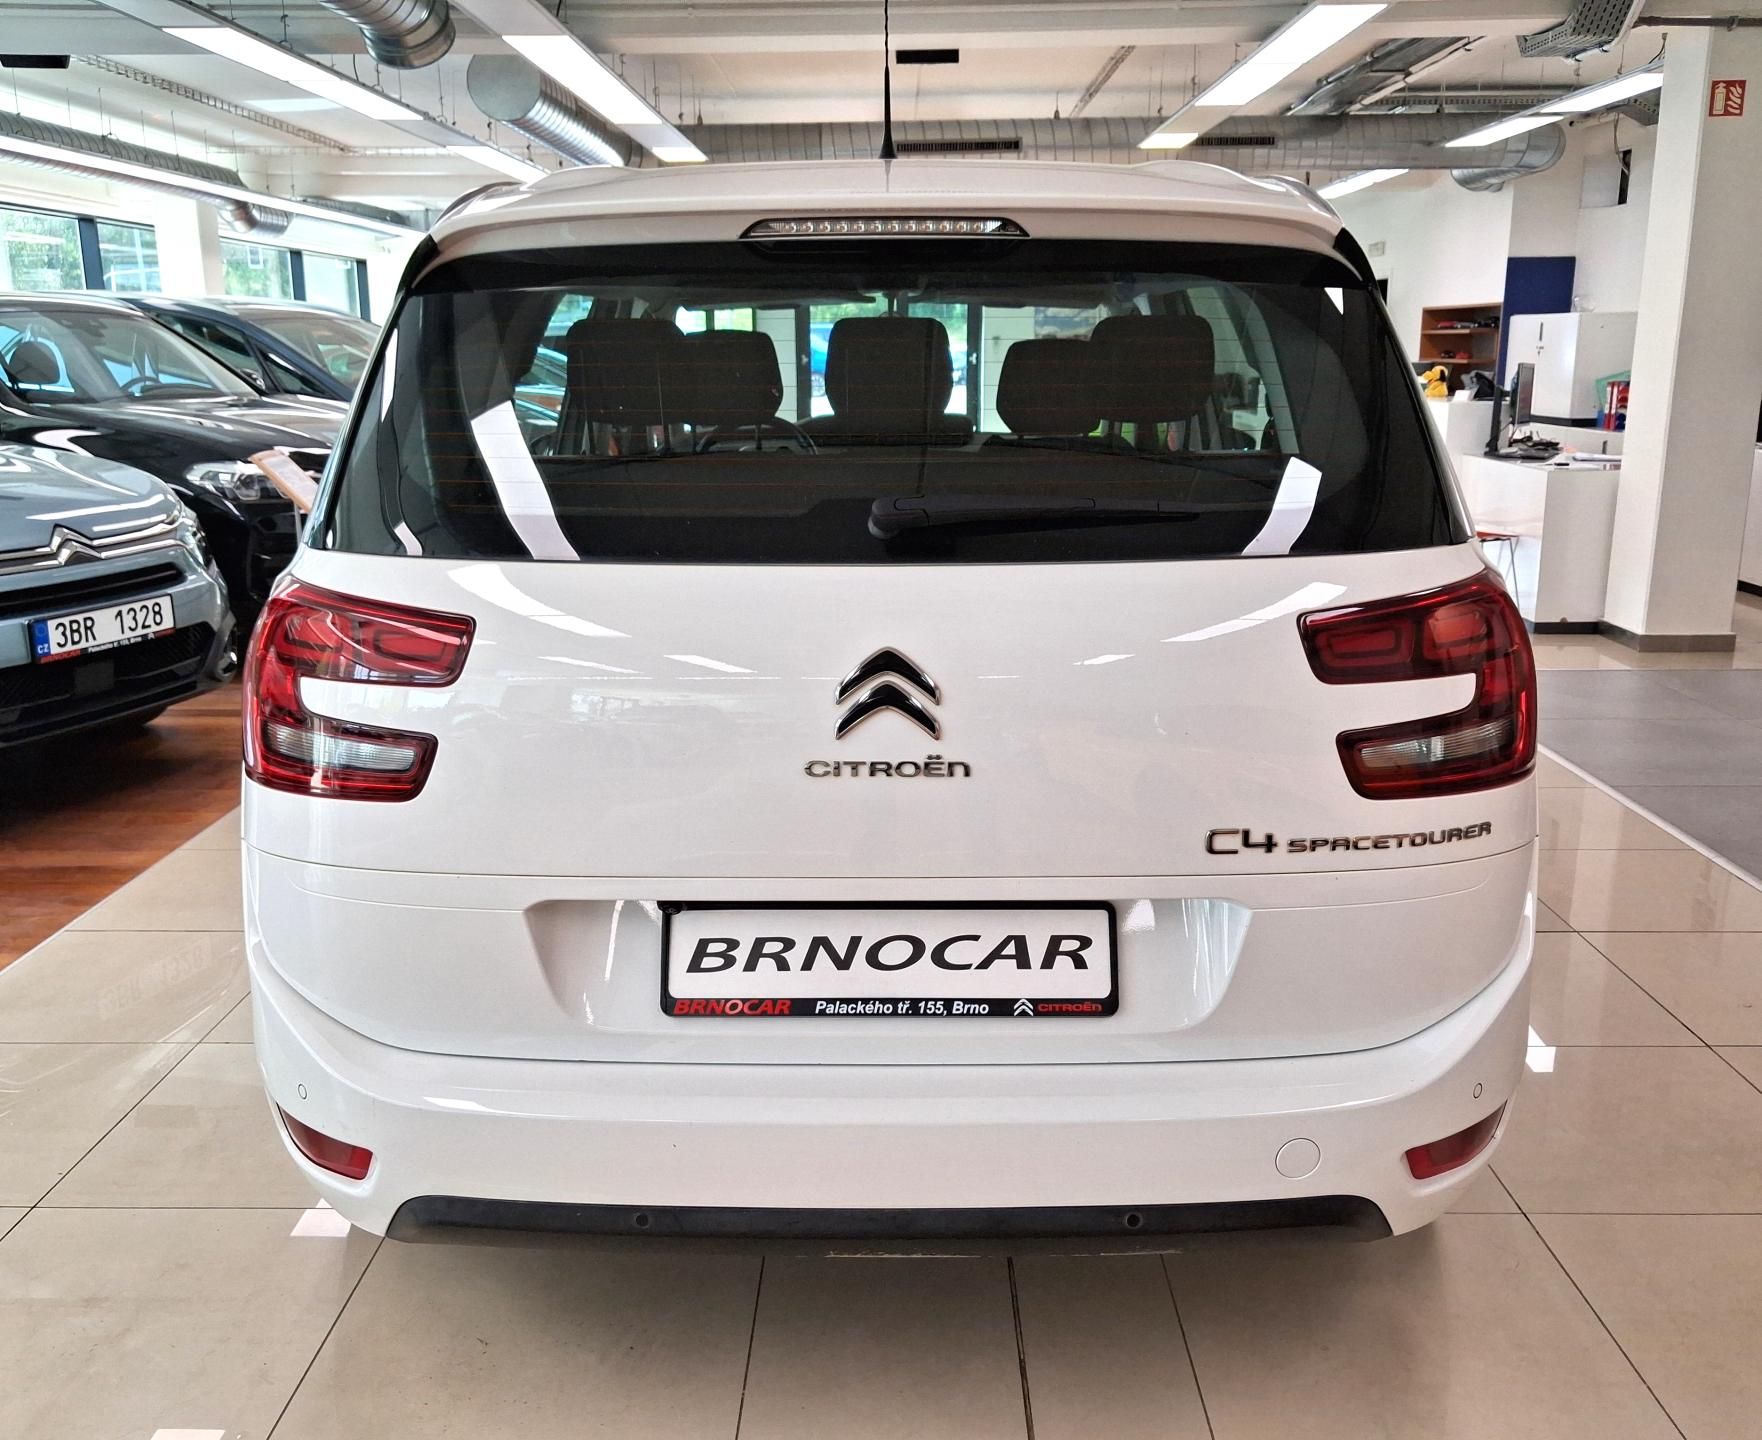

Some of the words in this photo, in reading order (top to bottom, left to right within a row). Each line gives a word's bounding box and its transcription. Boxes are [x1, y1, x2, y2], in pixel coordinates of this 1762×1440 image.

[55, 616, 97, 648] 3BR
[114, 602, 163, 634] 1328
[37, 643, 49, 654] CZ
[1205, 828, 1278, 855] C4
[1287, 821, 1492, 853] SPACETOURER
[686, 934, 1094, 973] BRNOCAR
[673, 999, 792, 1015] BRNOCAR
[815, 1000, 893, 1014] Palackého
[897, 1000, 913, 1014] tř.
[918, 1001, 948, 1016] 155,
[952, 1001, 990, 1014] Brno
